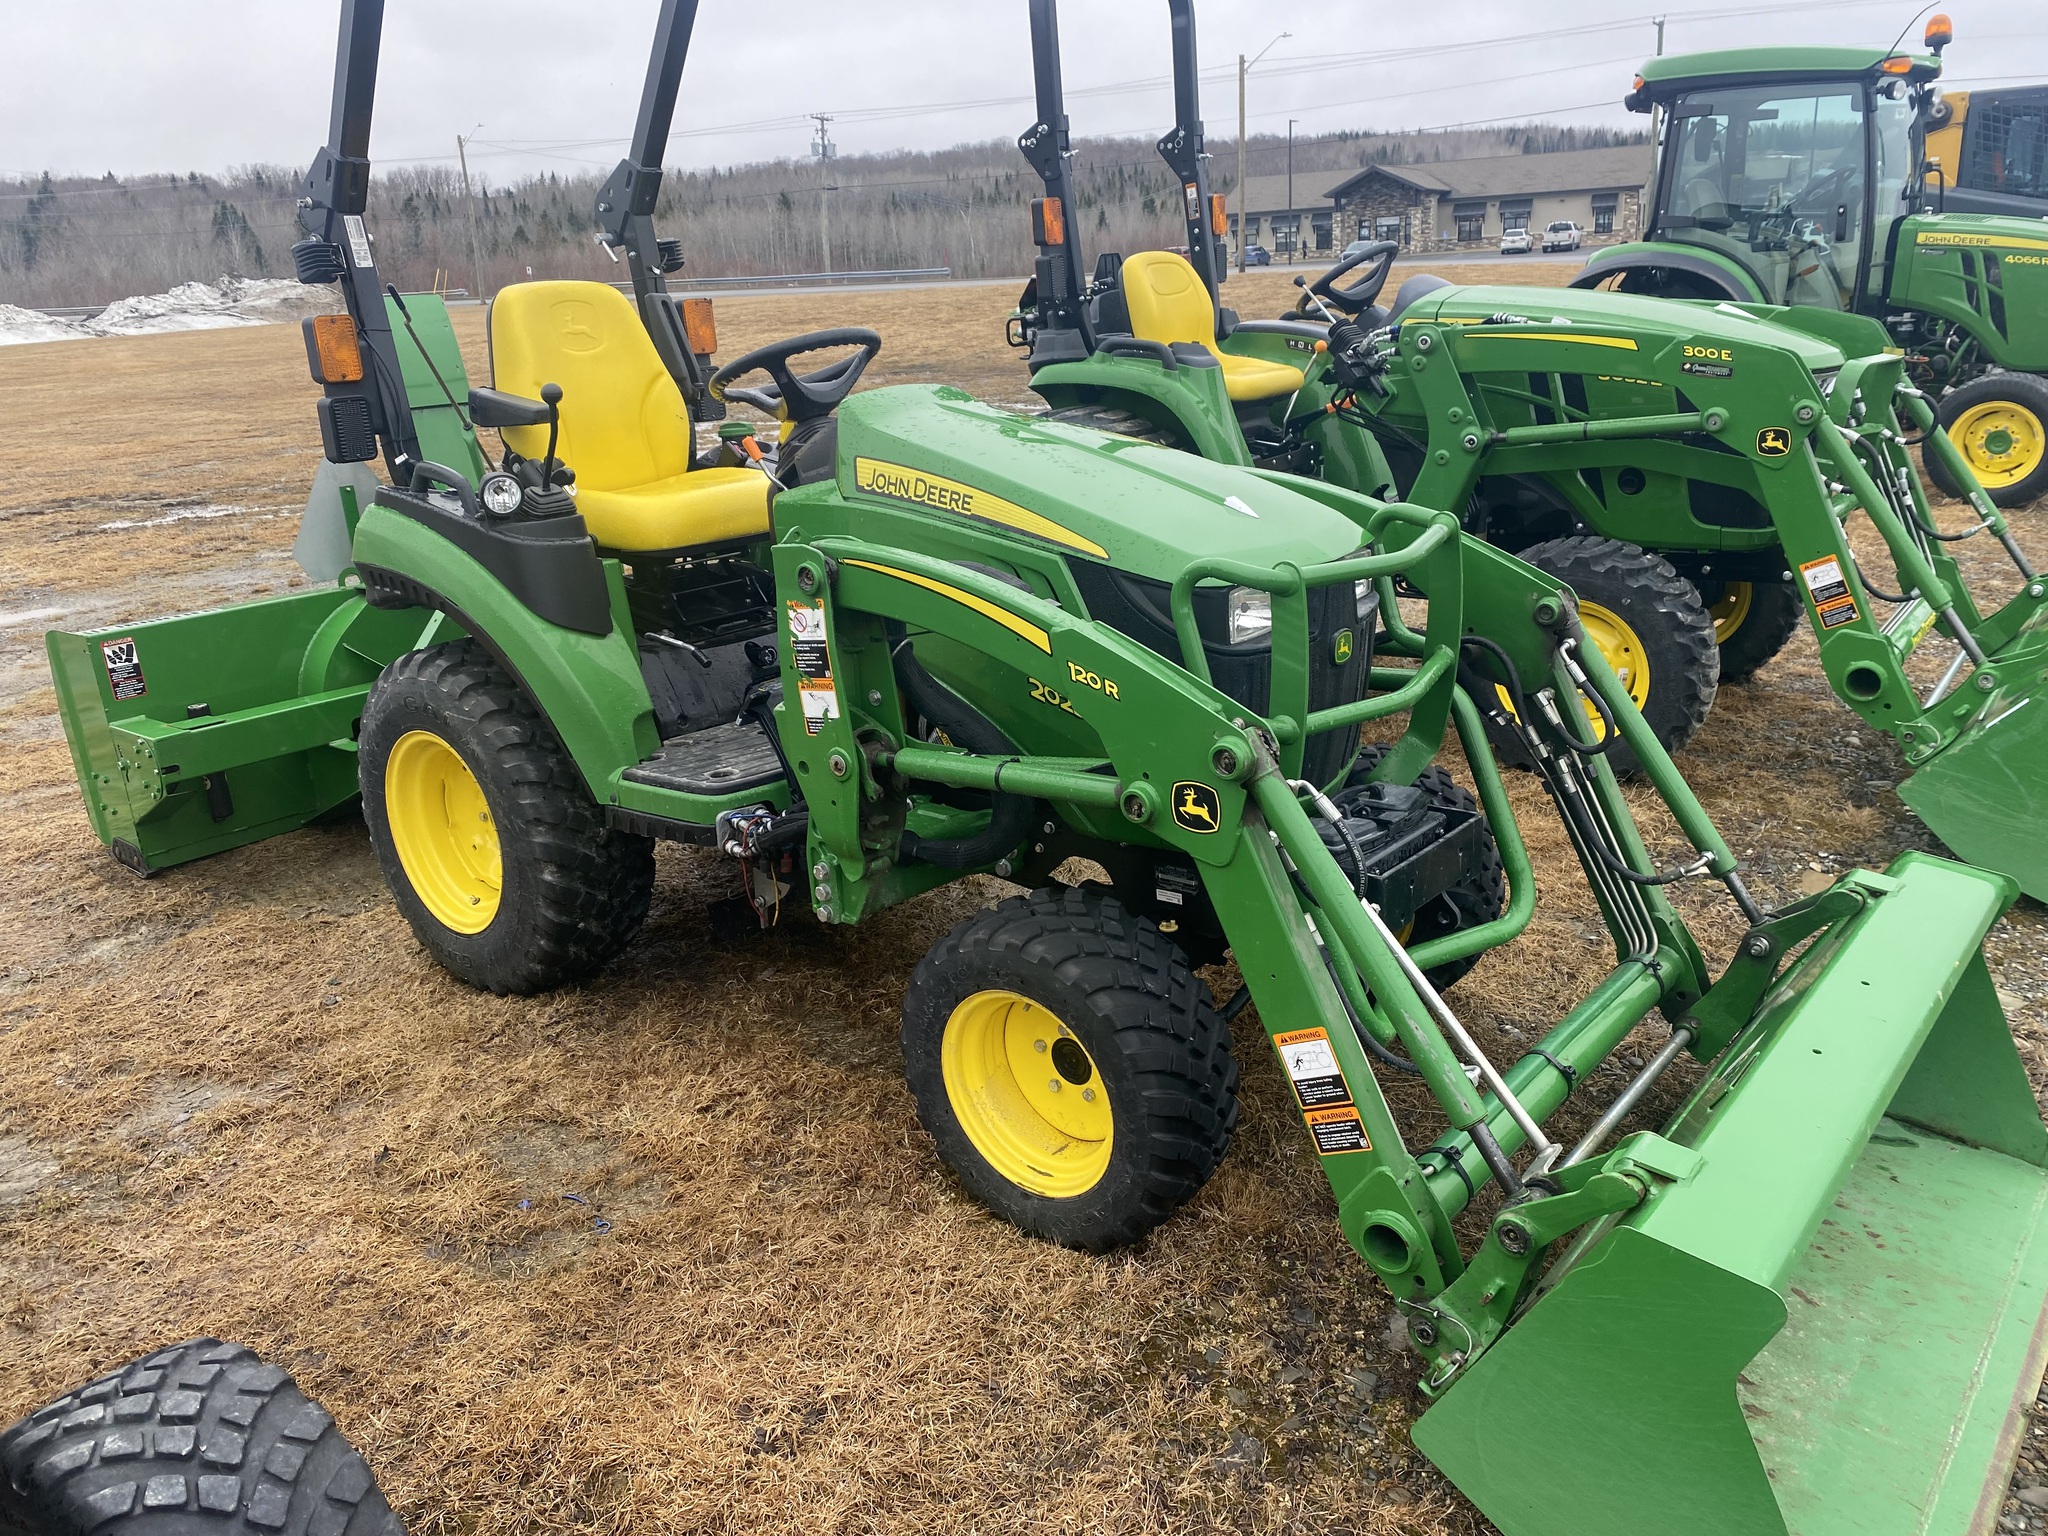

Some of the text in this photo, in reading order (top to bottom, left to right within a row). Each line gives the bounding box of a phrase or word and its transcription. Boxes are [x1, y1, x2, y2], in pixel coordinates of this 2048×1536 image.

[1921, 234, 1990, 246] JOHN DEERE
[866, 468, 974, 514] JOHN DEERE
[1027, 676, 1084, 720] 202
[1288, 1030, 1321, 1042] WARNING
[1320, 1110, 1354, 1120] WARNING
